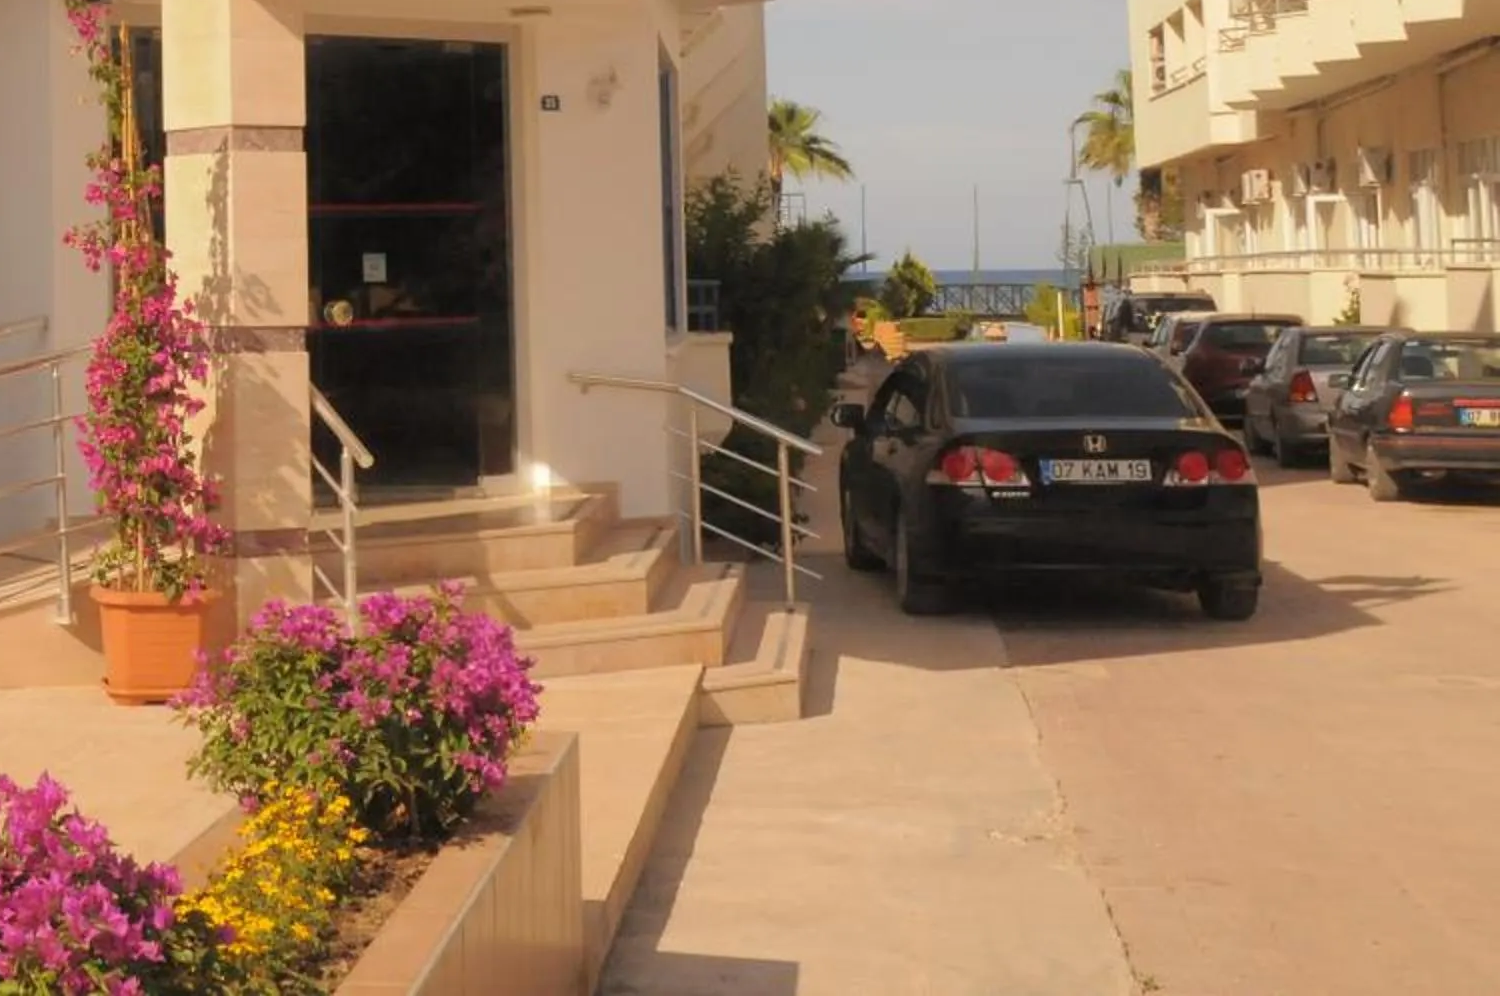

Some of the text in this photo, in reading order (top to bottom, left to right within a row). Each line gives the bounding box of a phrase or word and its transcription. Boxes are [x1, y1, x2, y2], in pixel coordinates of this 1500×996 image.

[1052, 461, 1148, 479] 07 KAM 19
